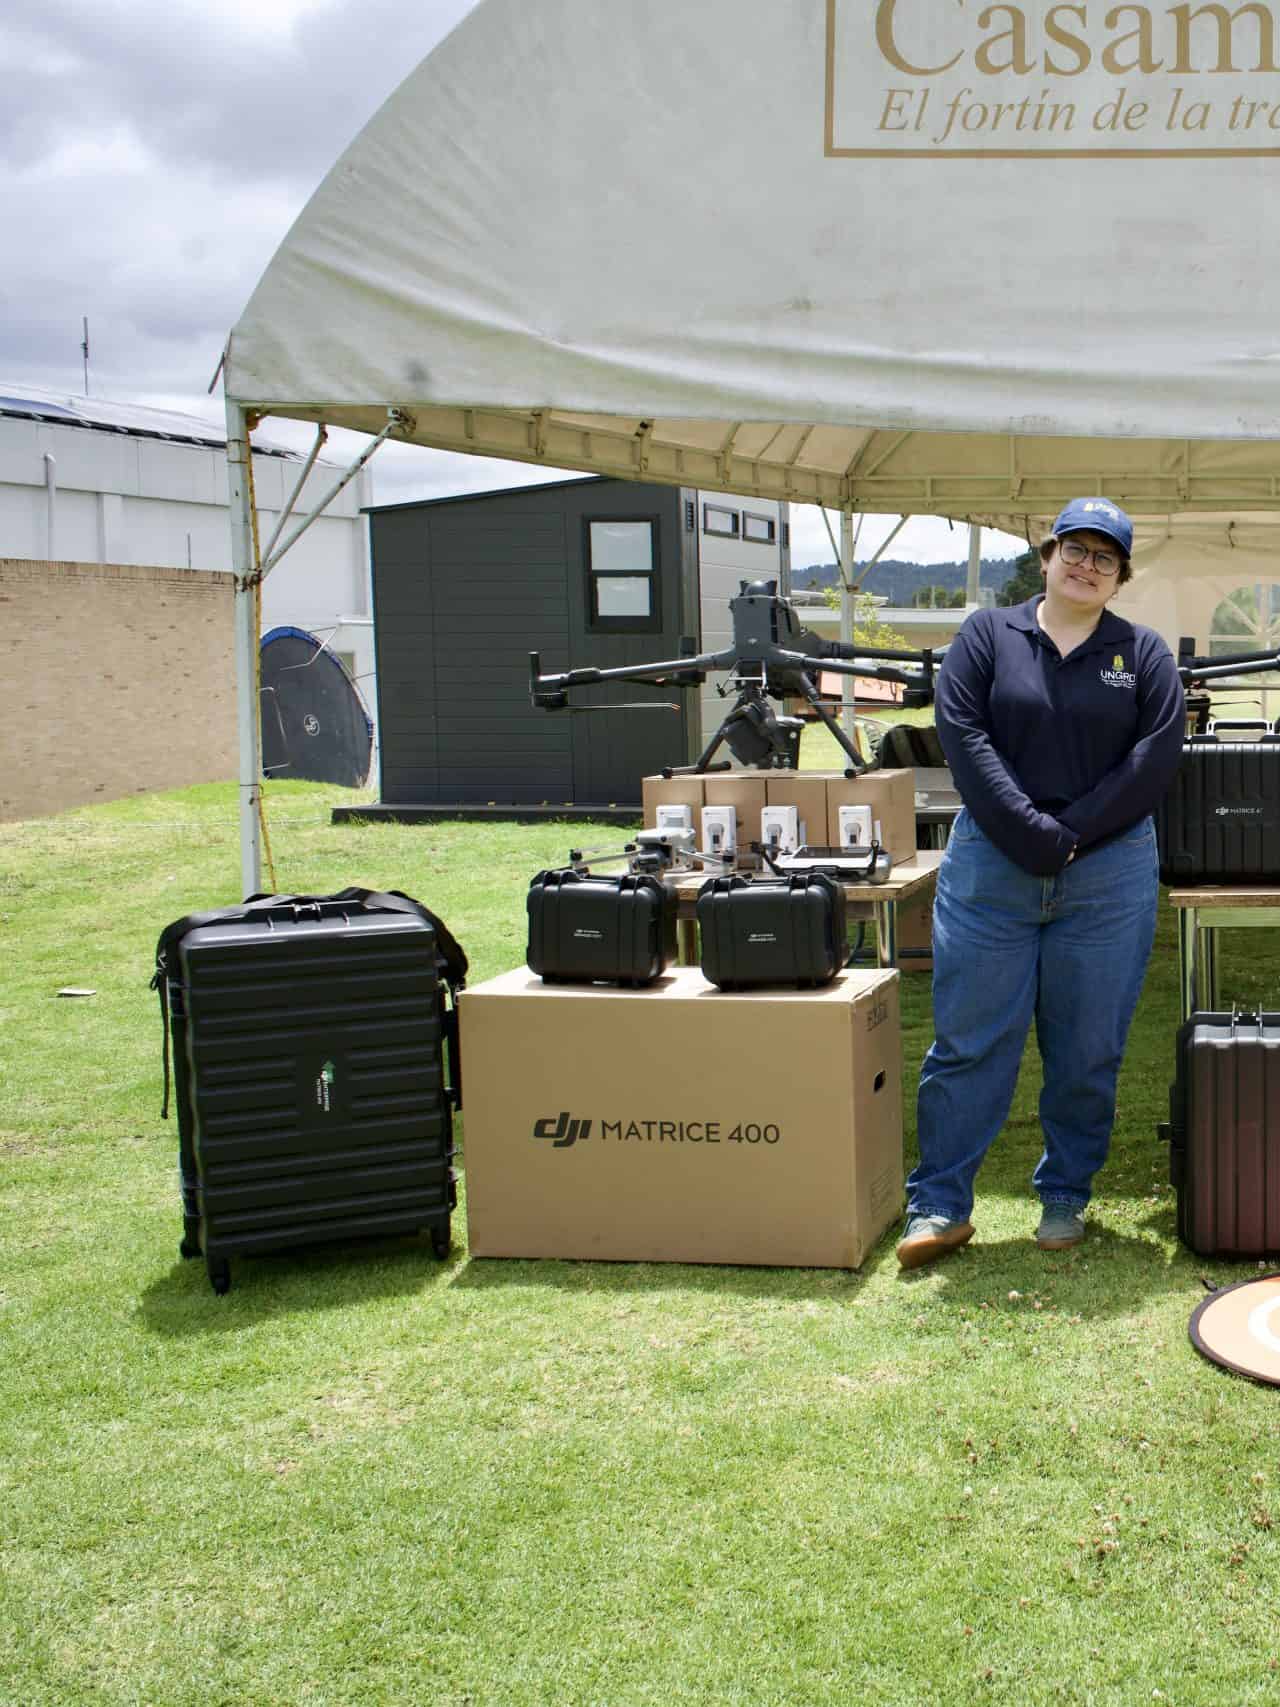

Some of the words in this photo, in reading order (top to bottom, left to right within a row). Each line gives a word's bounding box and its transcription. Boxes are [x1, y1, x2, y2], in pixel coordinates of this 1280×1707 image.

[876, 88, 928, 133] El
[931, 86, 1077, 145] fortín
[1092, 86, 1151, 132] de
[1165, 86, 1210, 132] la
[601, 1119, 721, 1143] MATRICE
[727, 1123, 780, 1145] 400
